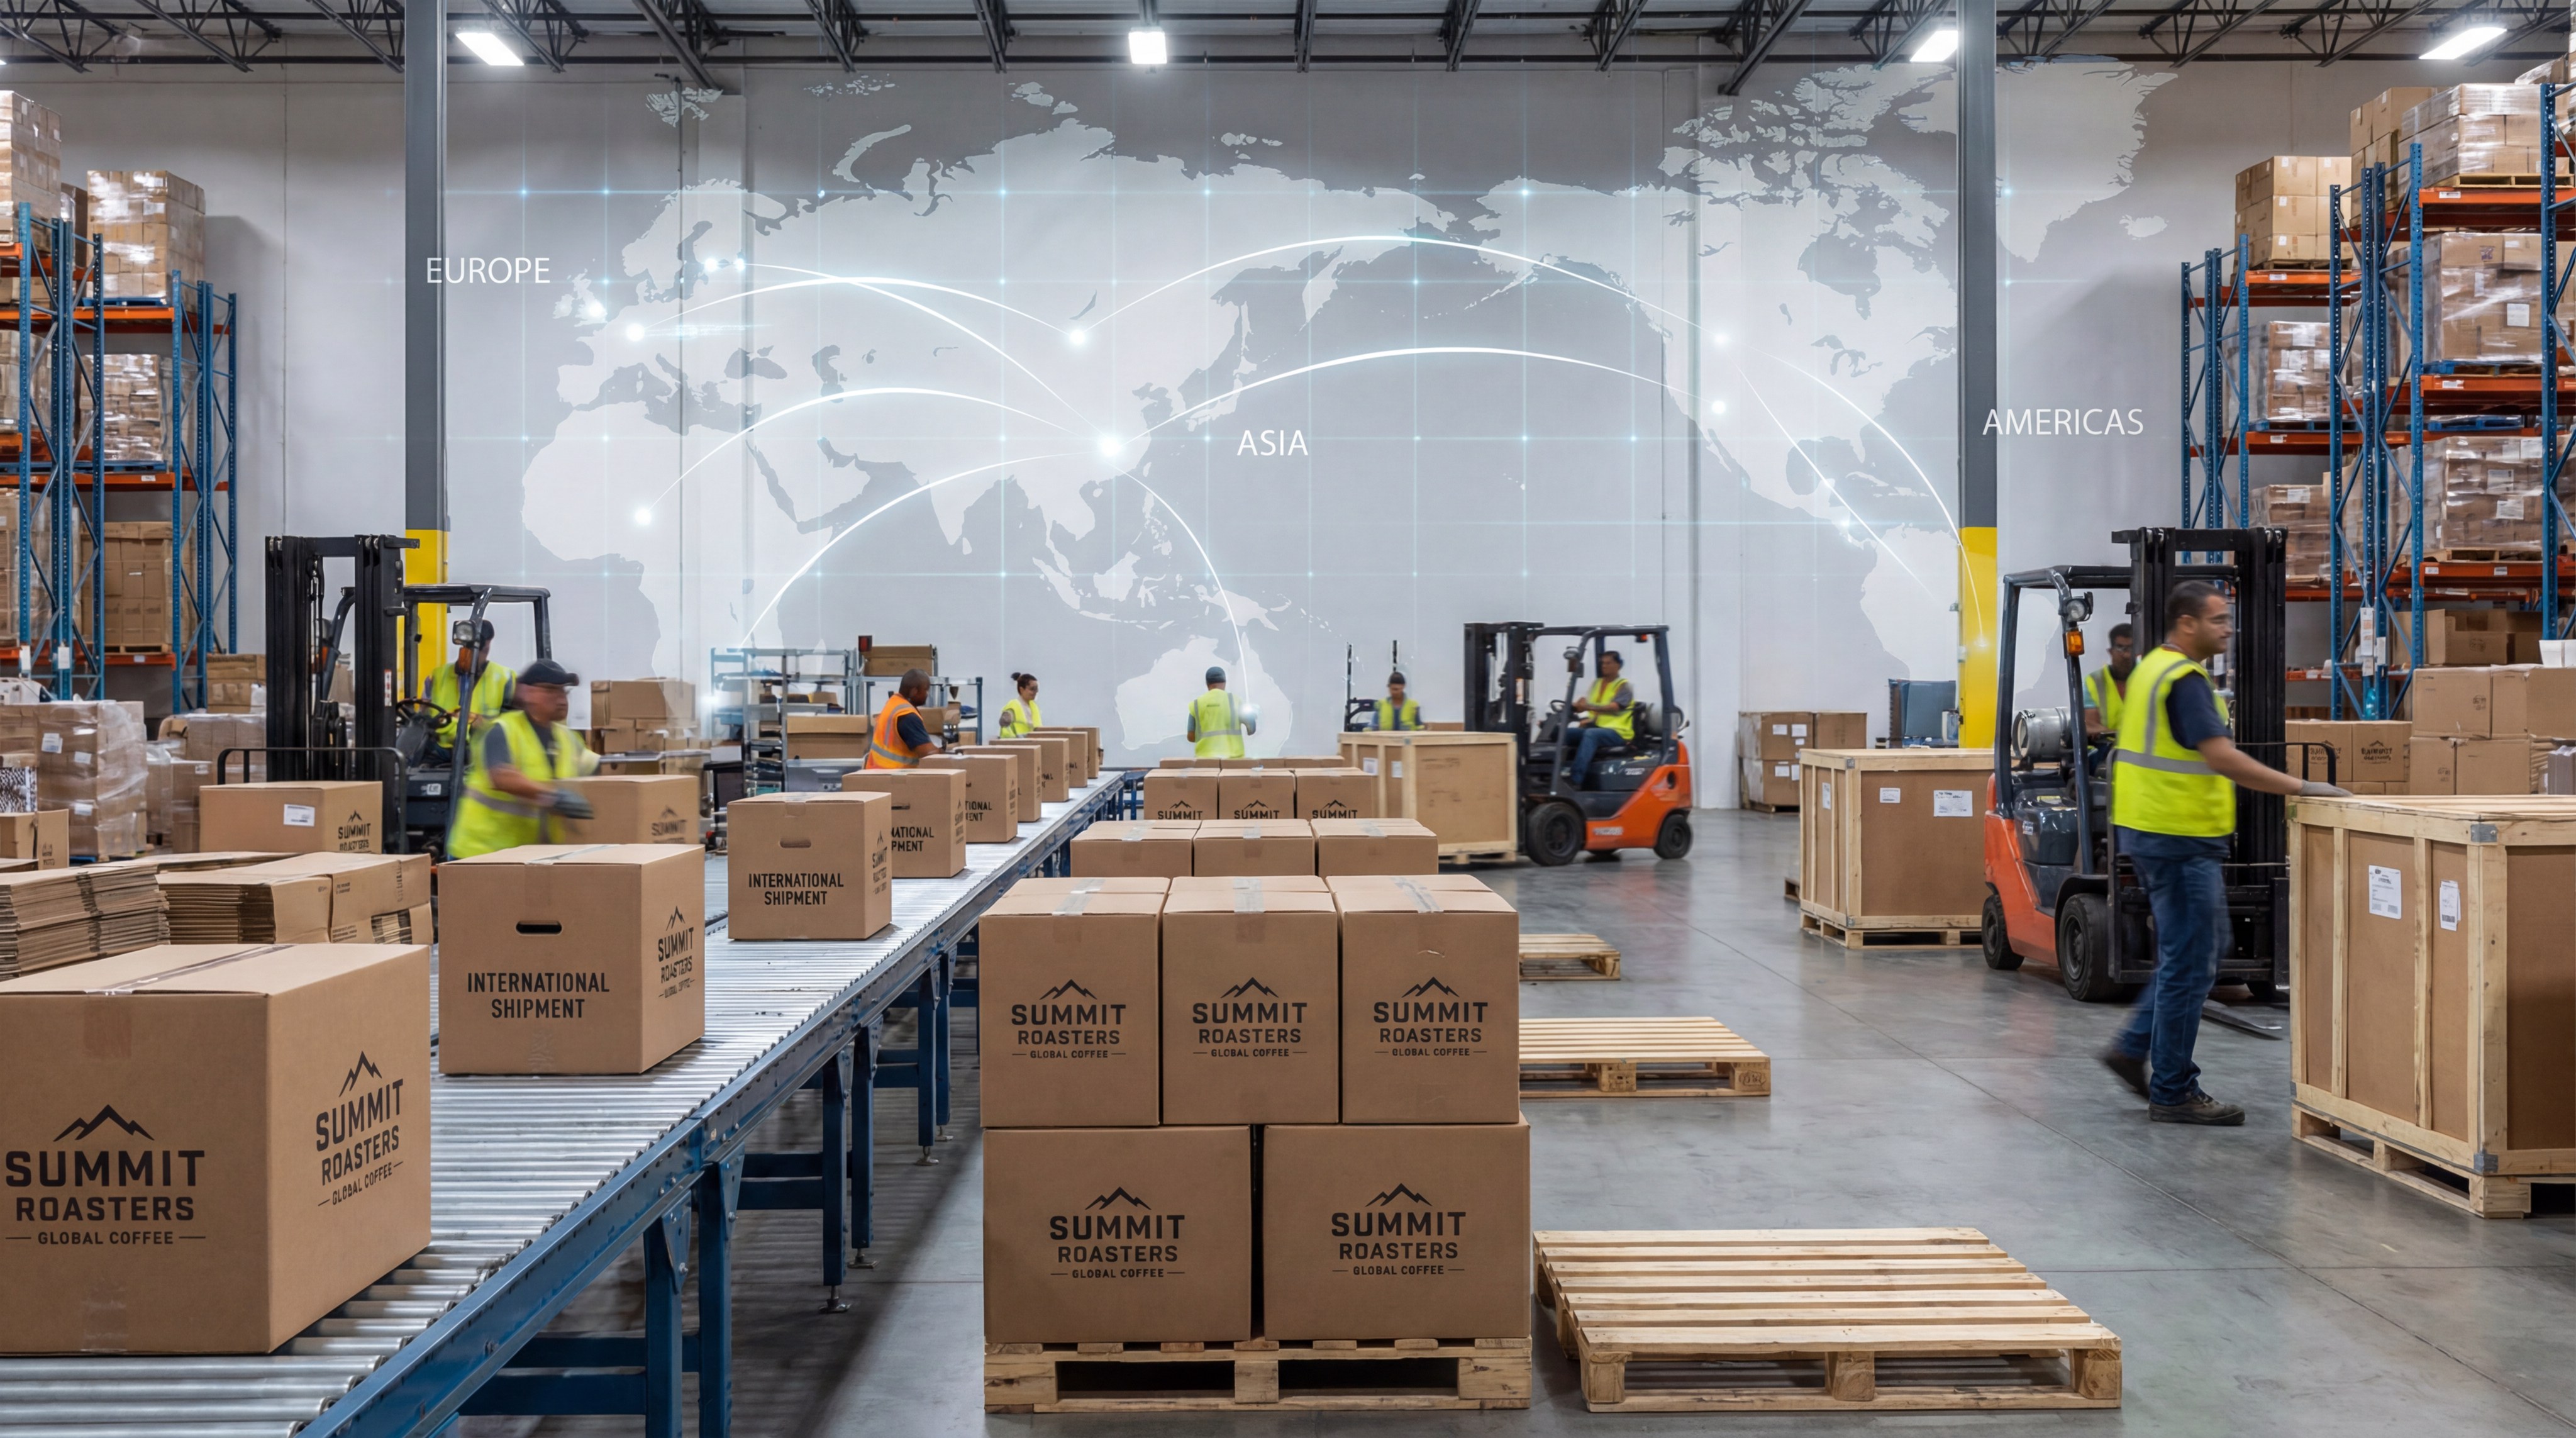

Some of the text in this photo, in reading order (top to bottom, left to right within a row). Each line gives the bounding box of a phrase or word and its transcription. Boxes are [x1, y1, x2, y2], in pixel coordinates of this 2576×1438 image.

[1158, 810, 1202, 820] SUMMIT
[1234, 810, 1280, 820] SUMMIT
[1313, 810, 1358, 819] SUMMIT
[338, 823, 371, 839] SUMMIT
[891, 827, 934, 838] ATIONAL
[891, 840, 923, 852] PMENT
[749, 873, 843, 888] INTERNATIONAL
[765, 891, 827, 905] SHIPMENT
[658, 927, 694, 962] SUMMIT
[468, 973, 609, 992] INTERNATIONAL
[492, 999, 585, 1018] SHIPMENT
[1012, 1005, 1126, 1025] SUMMIT
[1192, 1003, 1307, 1023] SUMMIT
[1374, 1002, 1488, 1023] SUMMIT
[1018, 1030, 1119, 1044] ROASTERS
[1199, 1028, 1301, 1044] ROASTERS
[1380, 1028, 1481, 1042] ROASTERS
[1253, 1049, 1289, 1057] COFFEE
[316, 1078, 404, 1152] SUMMIT
[322, 1125, 399, 1186] ROASTERS
[6, 1151, 204, 1187] SUMMIT
[332, 1162, 392, 1206] GLOBAL COFFEE
[16, 1196, 193, 1221] ROASTERS
[1050, 1215, 1185, 1240] SUMMIT
[1331, 1212, 1466, 1237] SUMMIT
[38, 1232, 173, 1244] GLOBAL COFFEE
[1058, 1246, 1177, 1262] ROASTERS
[1340, 1242, 1458, 1259] ROASTERS
[1072, 1269, 1163, 1278] GLOBAL COFFEE
[1353, 1266, 1443, 1275] GLOBAL COFFEE
